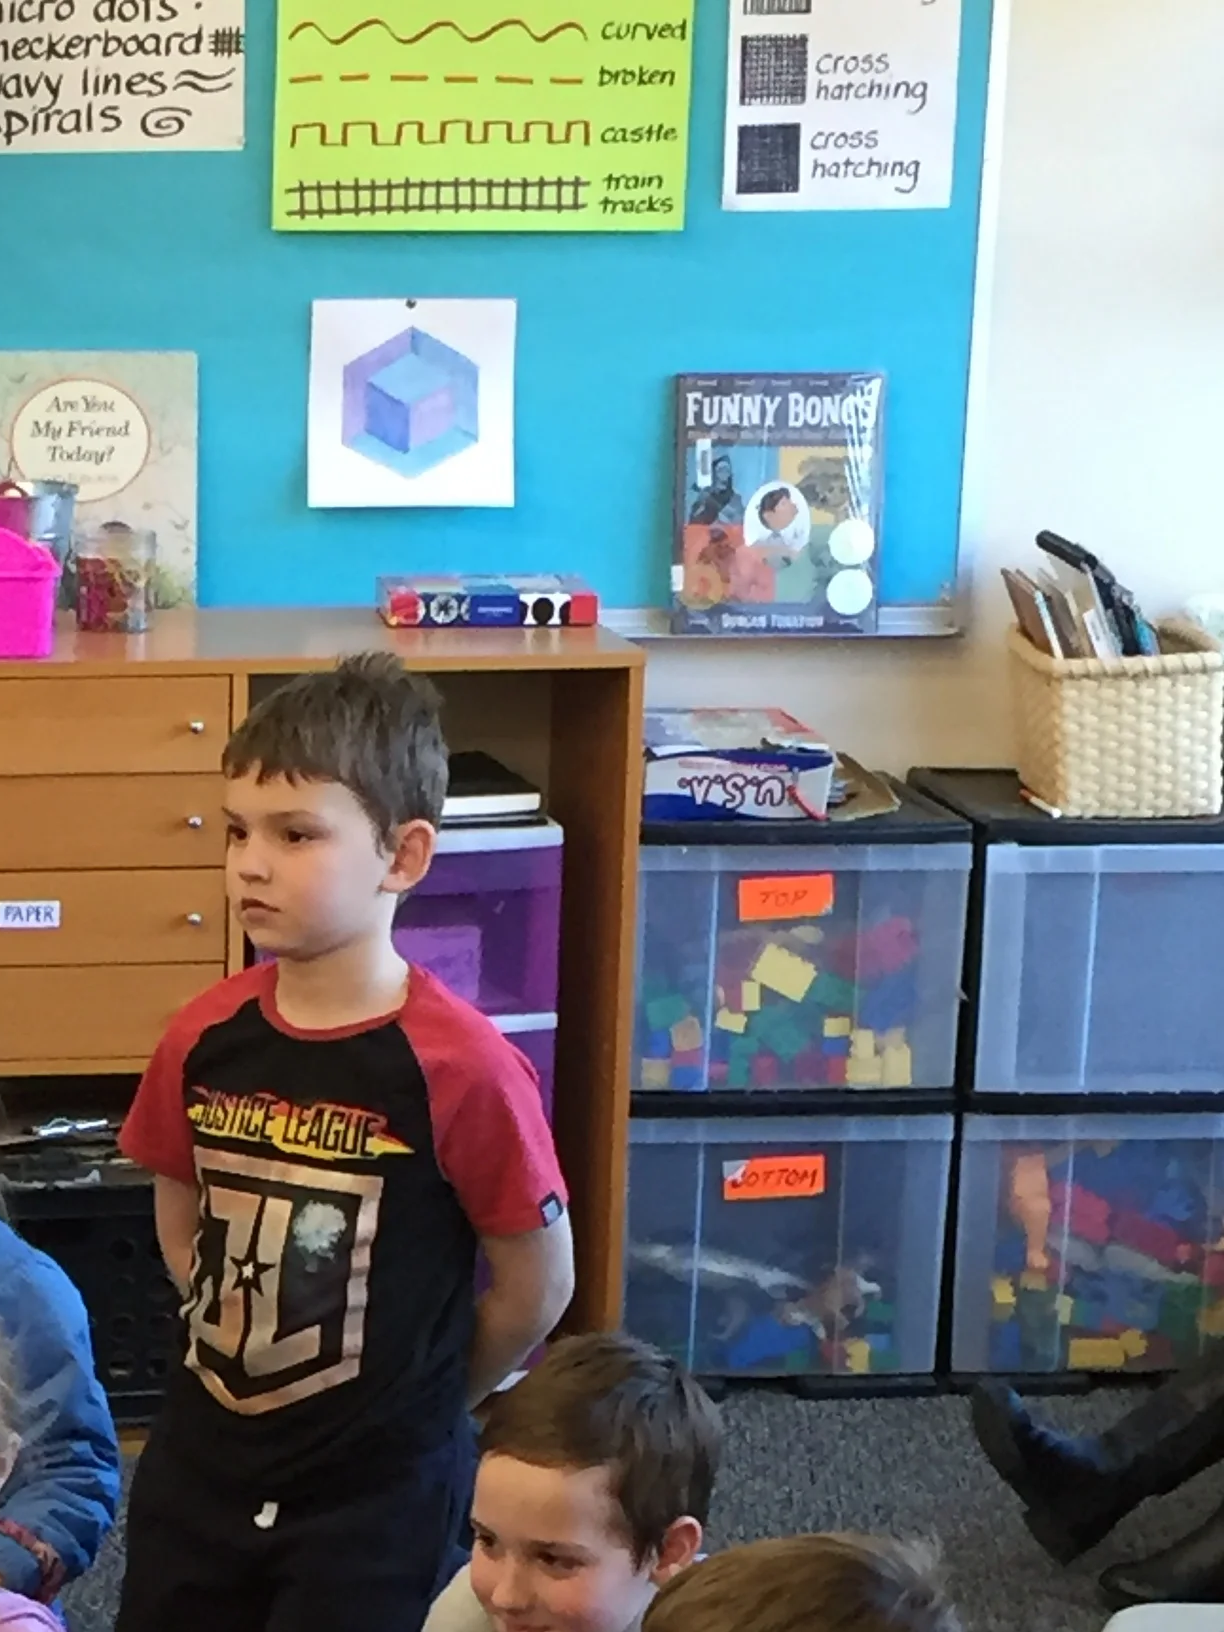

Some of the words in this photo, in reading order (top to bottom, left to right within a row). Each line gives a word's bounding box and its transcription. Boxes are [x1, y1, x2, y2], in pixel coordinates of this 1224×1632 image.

[92, 0, 178, 23] dots
[601, 18, 687, 41] curved
[815, 53, 890, 75] cross
[81, 66, 167, 97] lines
[598, 65, 676, 87] broken
[815, 80, 928, 115] hatching
[600, 124, 678, 144] castle
[810, 130, 879, 150] cross
[602, 173, 663, 192] train
[811, 157, 921, 194] hatching
[599, 196, 674, 215] tracks
[45, 396, 77, 413] Are
[81, 395, 116, 413] You
[685, 391, 782, 428] FUNNY
[787, 392, 878, 428] BONS
[30, 420, 62, 441] My
[67, 419, 131, 438] Friend
[46, 445, 116, 465] Today?
[759, 889, 808, 907] TOP
[4, 905, 54, 922] PAPER
[281, 1103, 380, 1157] LEAGUE
